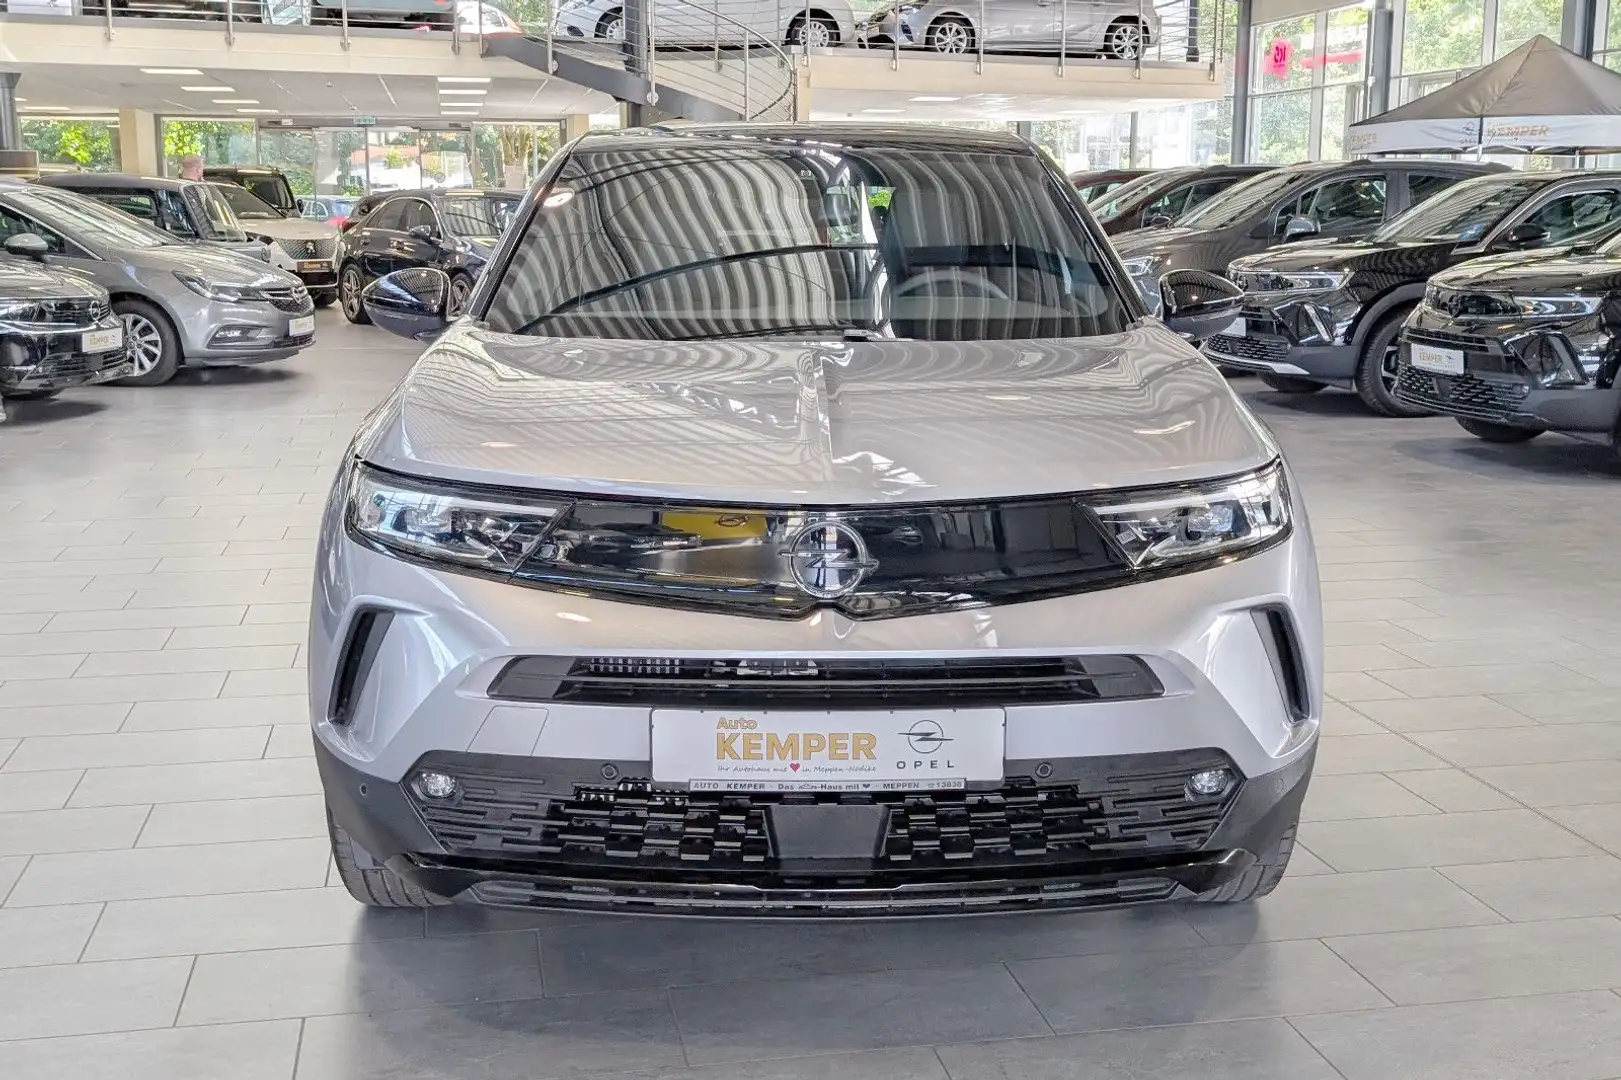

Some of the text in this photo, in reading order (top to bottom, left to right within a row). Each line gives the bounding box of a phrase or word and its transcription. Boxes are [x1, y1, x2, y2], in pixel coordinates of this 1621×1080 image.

[1486, 124, 1550, 137] KEMPER
[716, 717, 758, 730] Auto
[716, 732, 877, 760] KEMPER
[896, 760, 955, 769] OPEL
